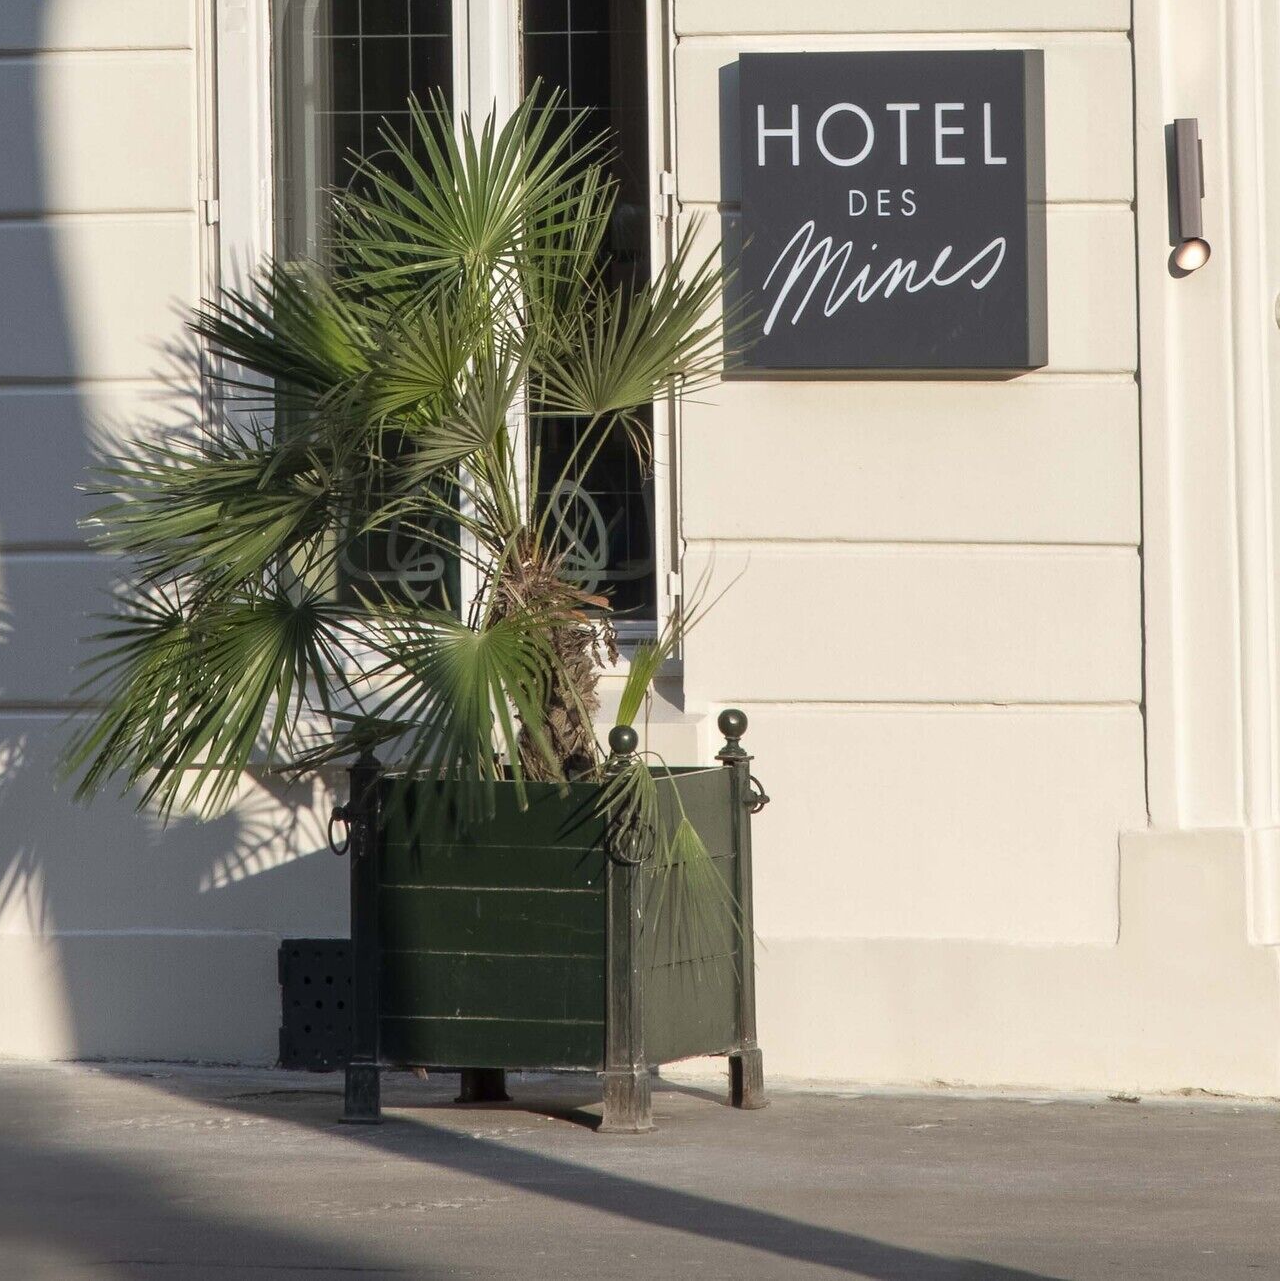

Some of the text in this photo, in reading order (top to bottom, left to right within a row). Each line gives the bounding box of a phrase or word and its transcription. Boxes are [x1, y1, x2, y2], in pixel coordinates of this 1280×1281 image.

[757, 102, 1008, 167] HOTEL
[848, 188, 918, 217] DES
[762, 220, 1007, 336] Mines
